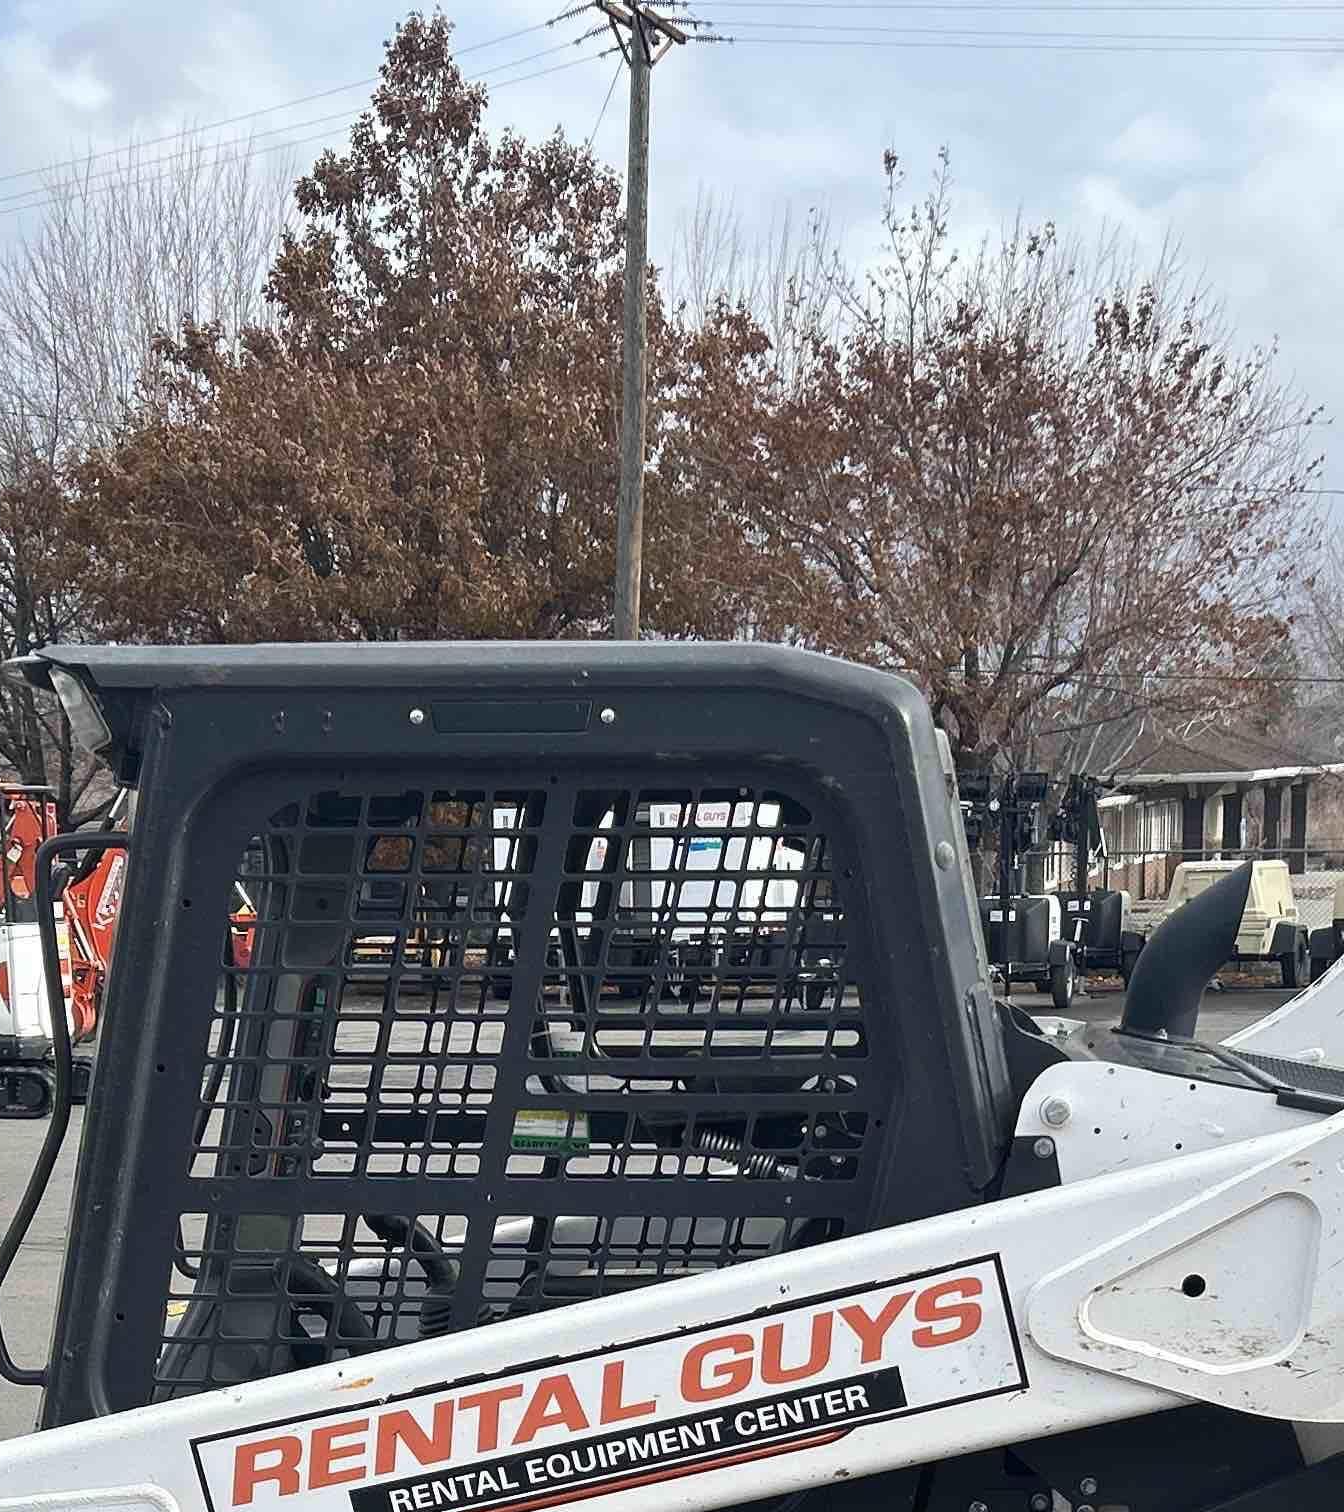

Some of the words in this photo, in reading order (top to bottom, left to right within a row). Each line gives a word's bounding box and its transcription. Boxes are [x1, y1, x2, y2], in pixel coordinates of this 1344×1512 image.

[232, 1361, 657, 1507] RENTAL
[680, 1276, 983, 1404] GUYS
[525, 1417, 724, 1483] EQUIPMENT
[734, 1384, 871, 1437] CENTER
